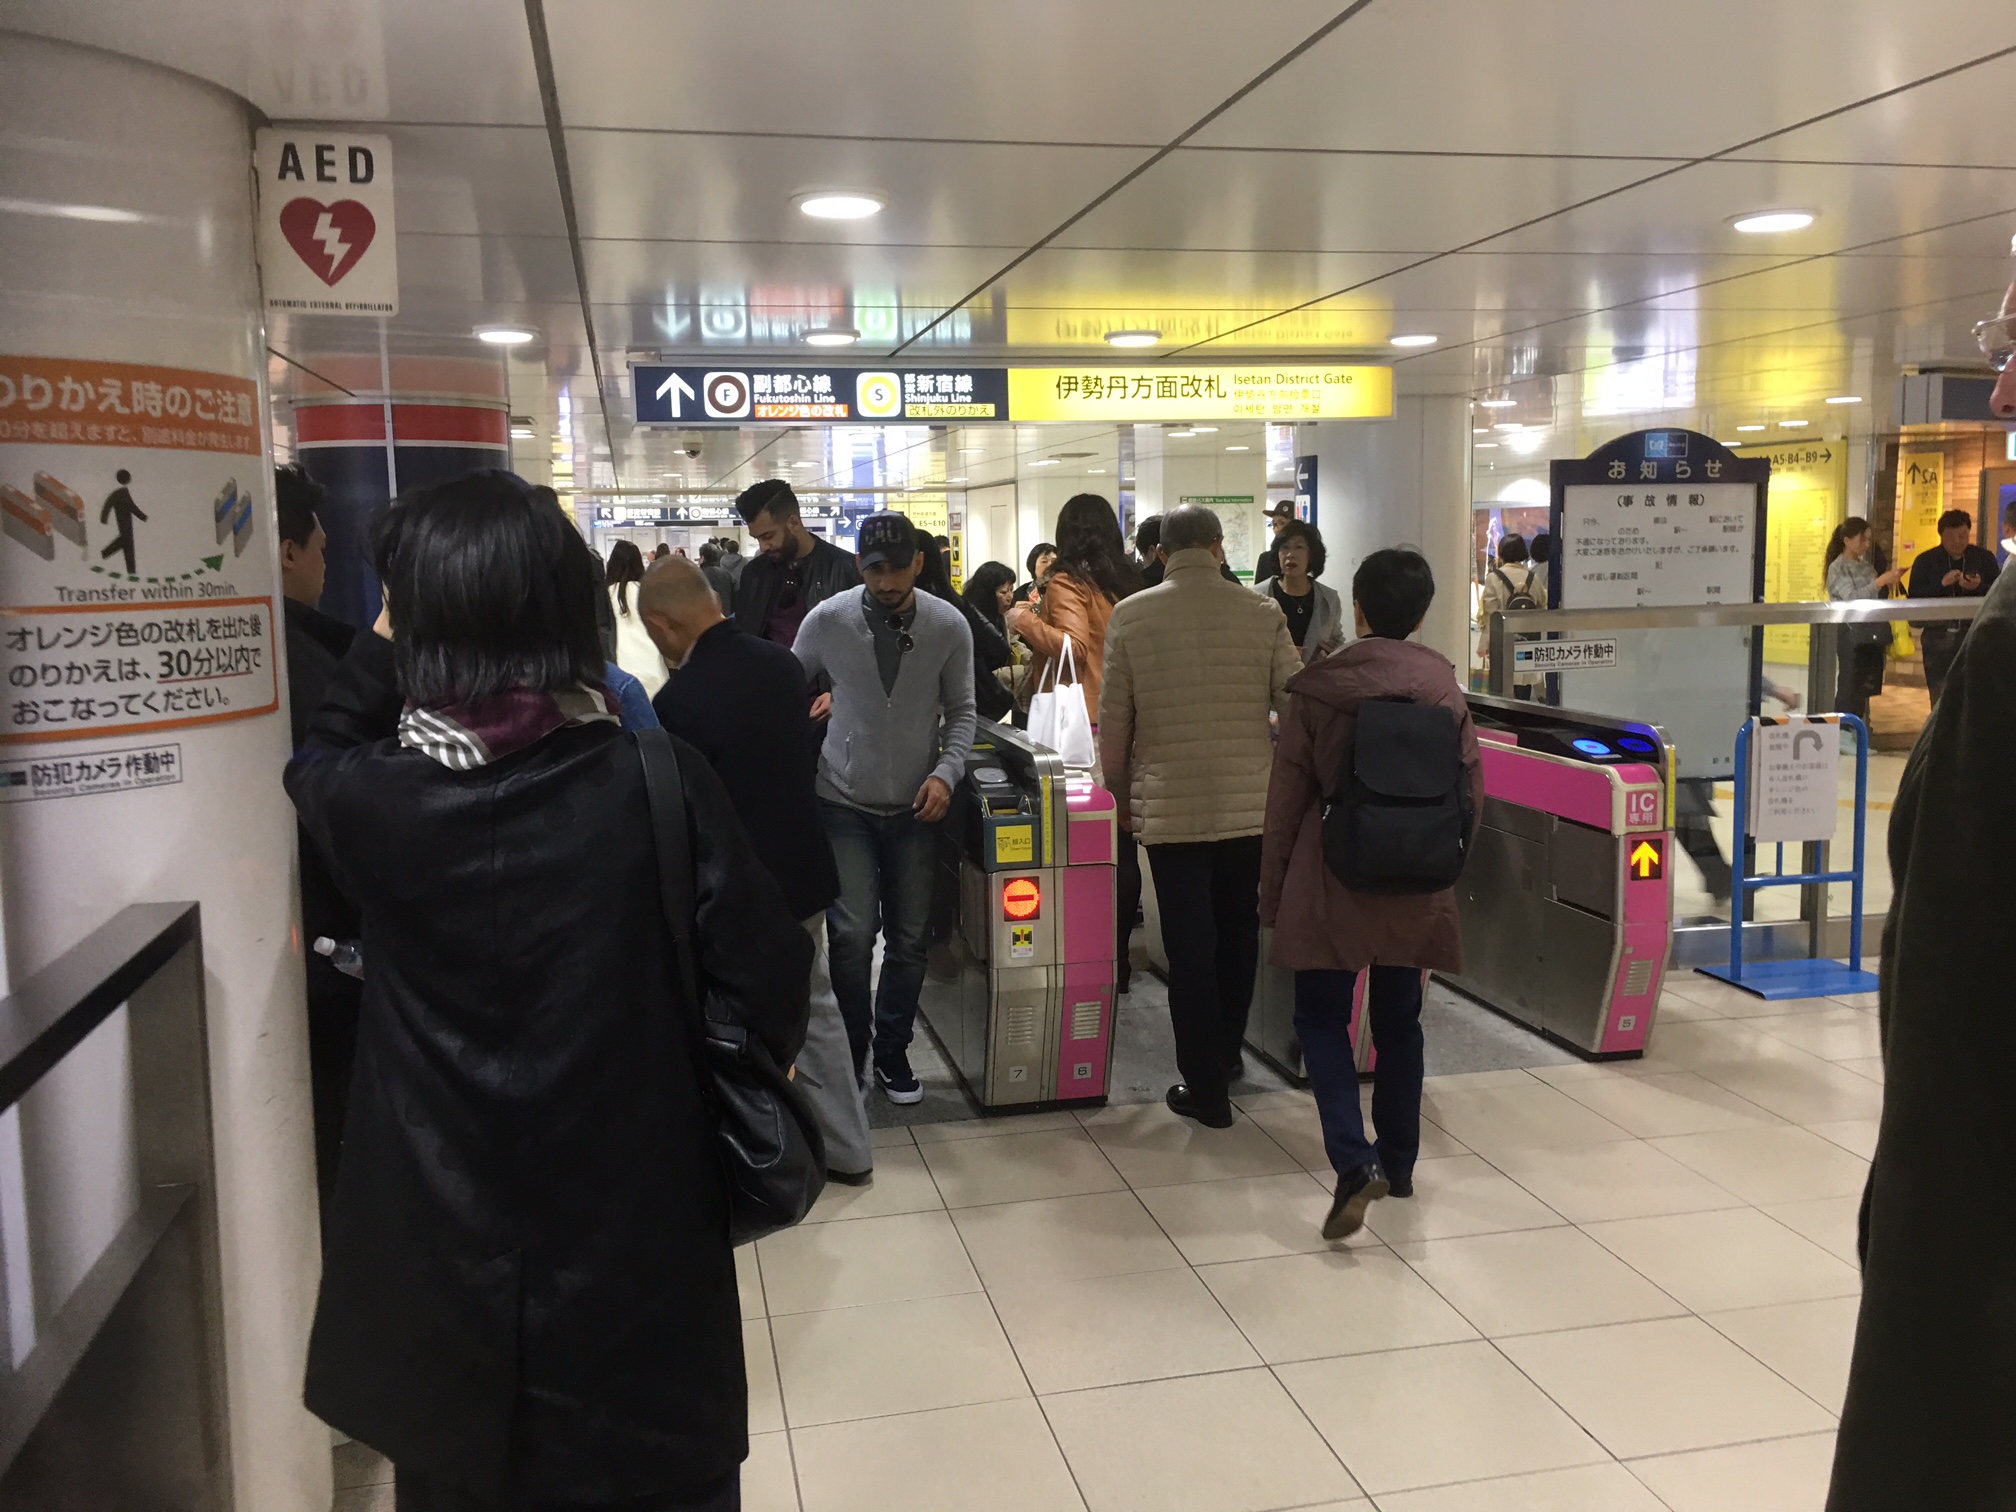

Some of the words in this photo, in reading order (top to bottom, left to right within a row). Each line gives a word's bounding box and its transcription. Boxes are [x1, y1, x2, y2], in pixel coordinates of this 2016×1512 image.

[278, 142, 374, 184] AED
[753, 374, 832, 394] 副都心線
[1056, 374, 1227, 400] 伊勢丹方面改札
[1233, 374, 1272, 385] Isetan
[1275, 373, 1320, 385] District
[1324, 373, 1353, 385] Gate
[723, 388, 731, 402] F
[754, 393, 811, 404] Fukutoshin
[814, 393, 836, 404] Line
[874, 388, 884, 402] S
[904, 393, 949, 405] Shinjuku
[951, 393, 973, 403] Line
[757, 404, 847, 418] オレンジ色の改札
[909, 404, 990, 417] 改札外のりかえ
[1608, 459, 1722, 480] お知らせ
[54, 584, 136, 602] Transfer
[141, 581, 193, 600] within
[198, 582, 239, 598] 30min.
[7, 614, 262, 651] オレンジ色の改札を出た後
[1534, 643, 1613, 663] 防犯カメラ作動中
[9, 644, 262, 687] のりかえは、30分以内で
[13, 686, 230, 725] おこなってください。
[31, 750, 175, 787] 防犯カメラ作動中
[1631, 792, 1655, 812] IC
[1622, 1018, 1632, 1028] 5
[1013, 1069, 1023, 1079] 7
[1077, 1066, 1087, 1076] 6
